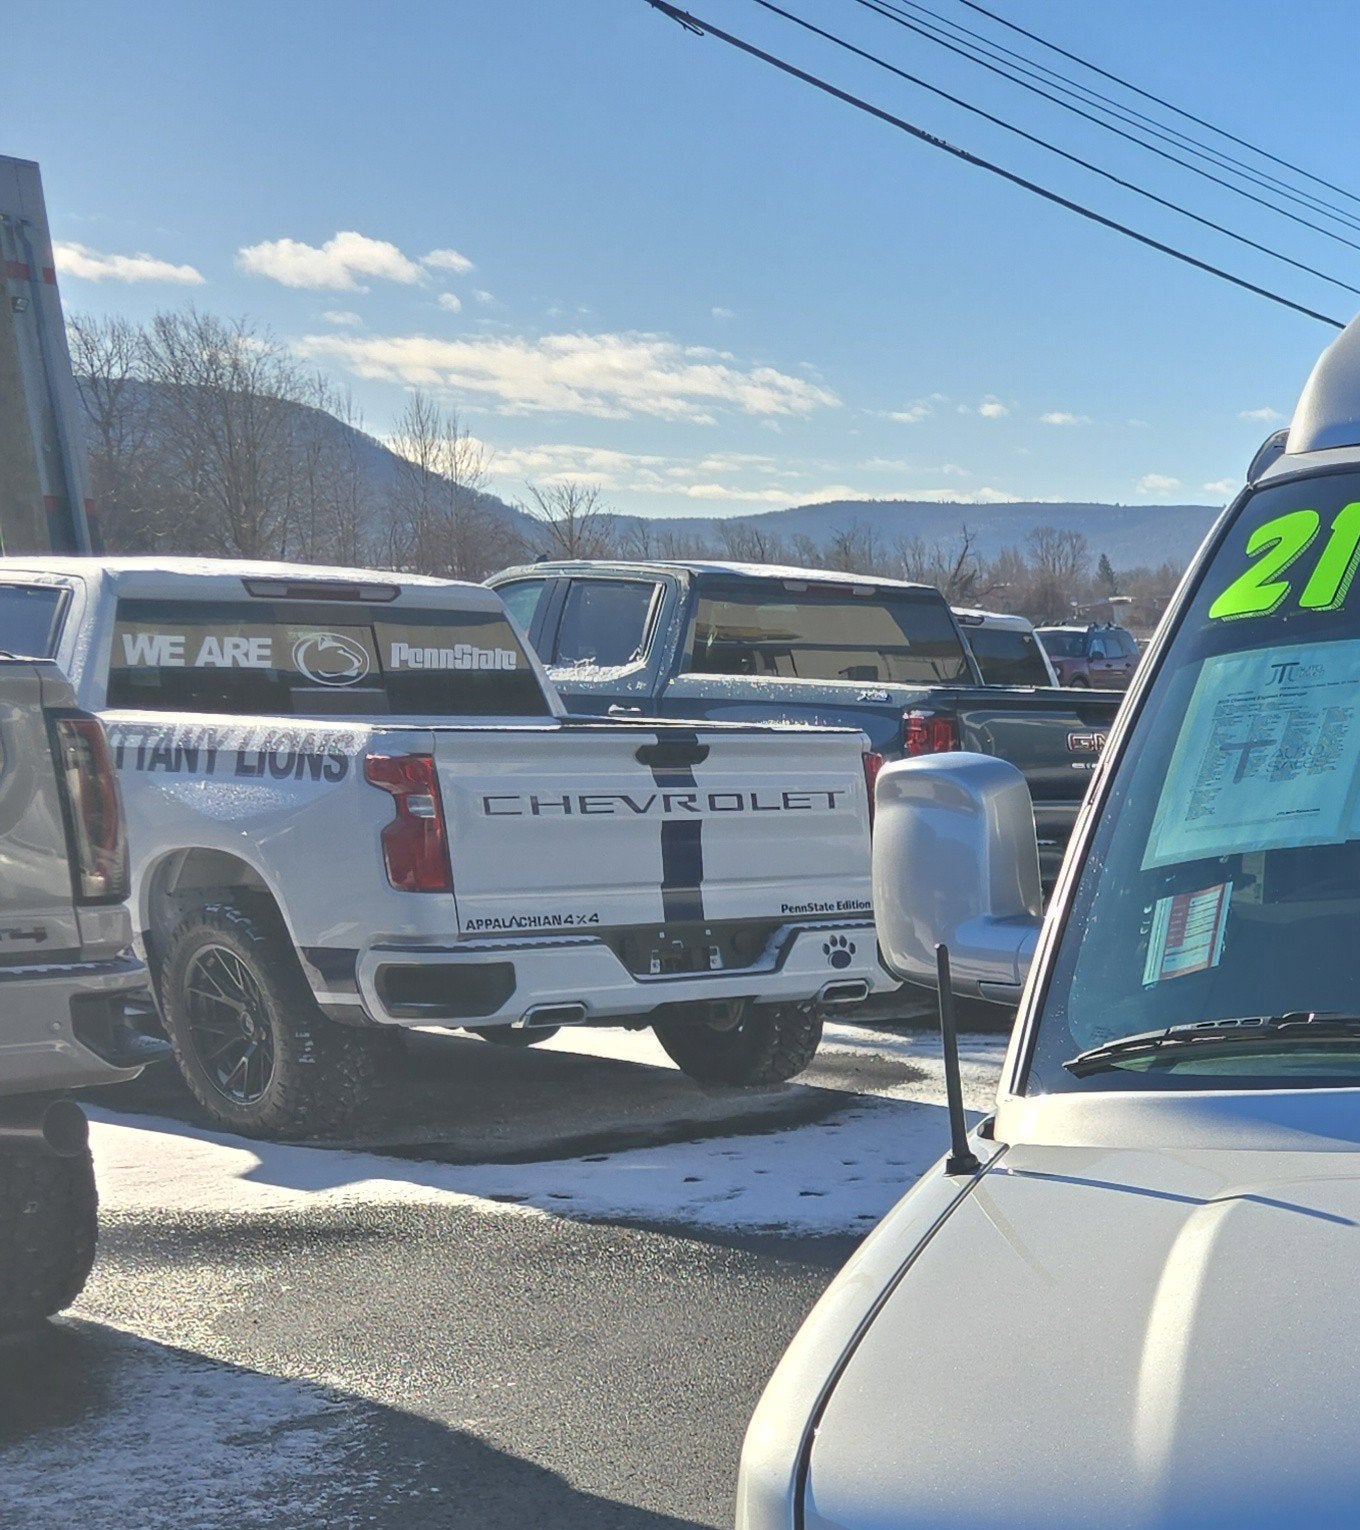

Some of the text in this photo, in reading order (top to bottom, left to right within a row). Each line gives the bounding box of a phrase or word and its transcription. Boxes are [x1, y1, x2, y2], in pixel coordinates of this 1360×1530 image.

[122, 633, 273, 669] WE ARE
[234, 727, 355, 783] LIONS
[482, 789, 846, 816] CHEVROLET
[836, 899, 871, 911] Edition
